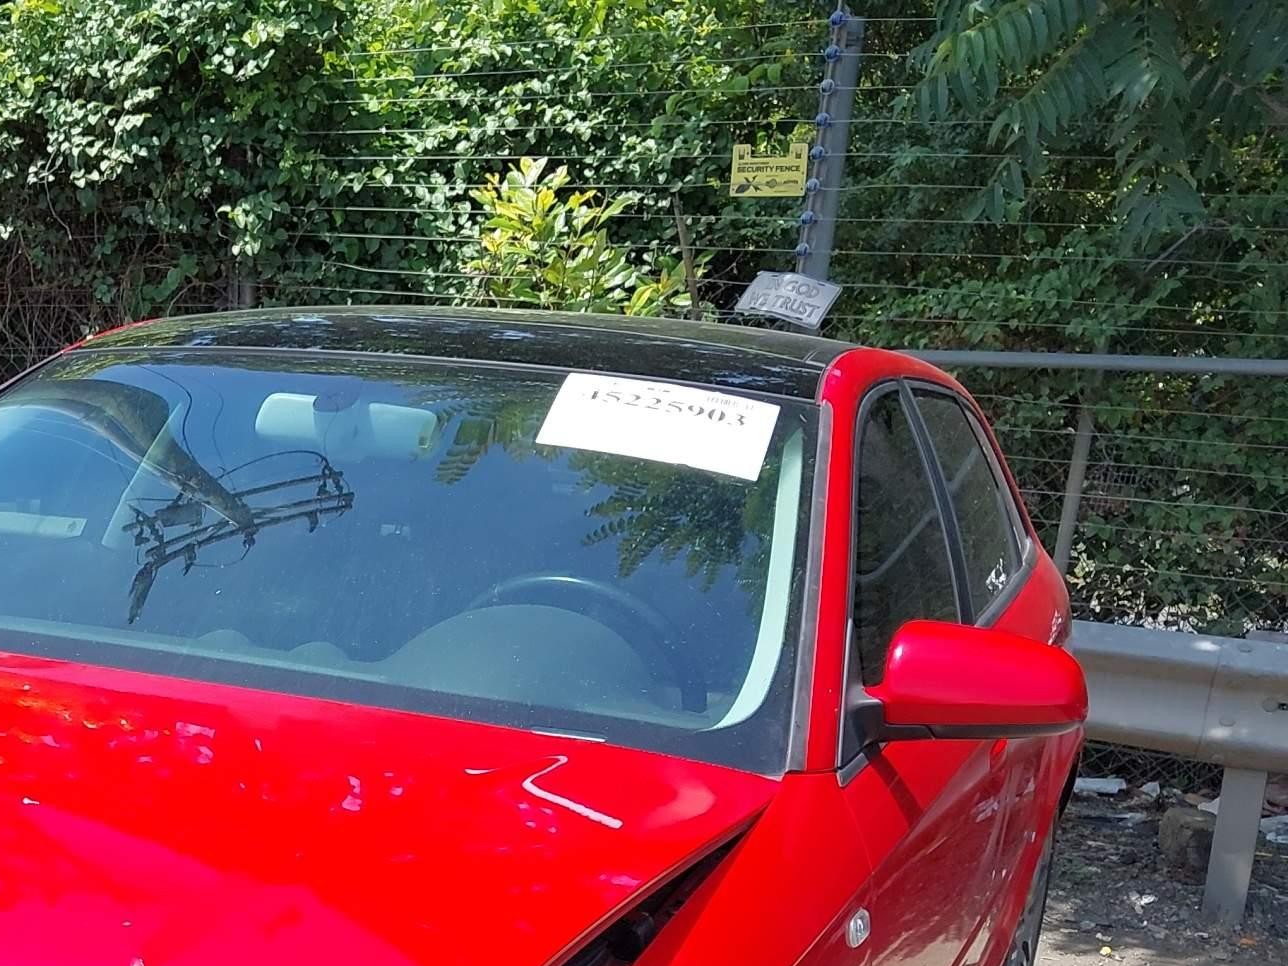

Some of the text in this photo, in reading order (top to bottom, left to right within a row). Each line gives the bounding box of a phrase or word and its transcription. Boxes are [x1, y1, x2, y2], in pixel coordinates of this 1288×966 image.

[737, 165, 801, 174] SECURITY FENCE
[784, 280, 820, 299] GOD
[750, 292, 821, 318] WE TRUST
